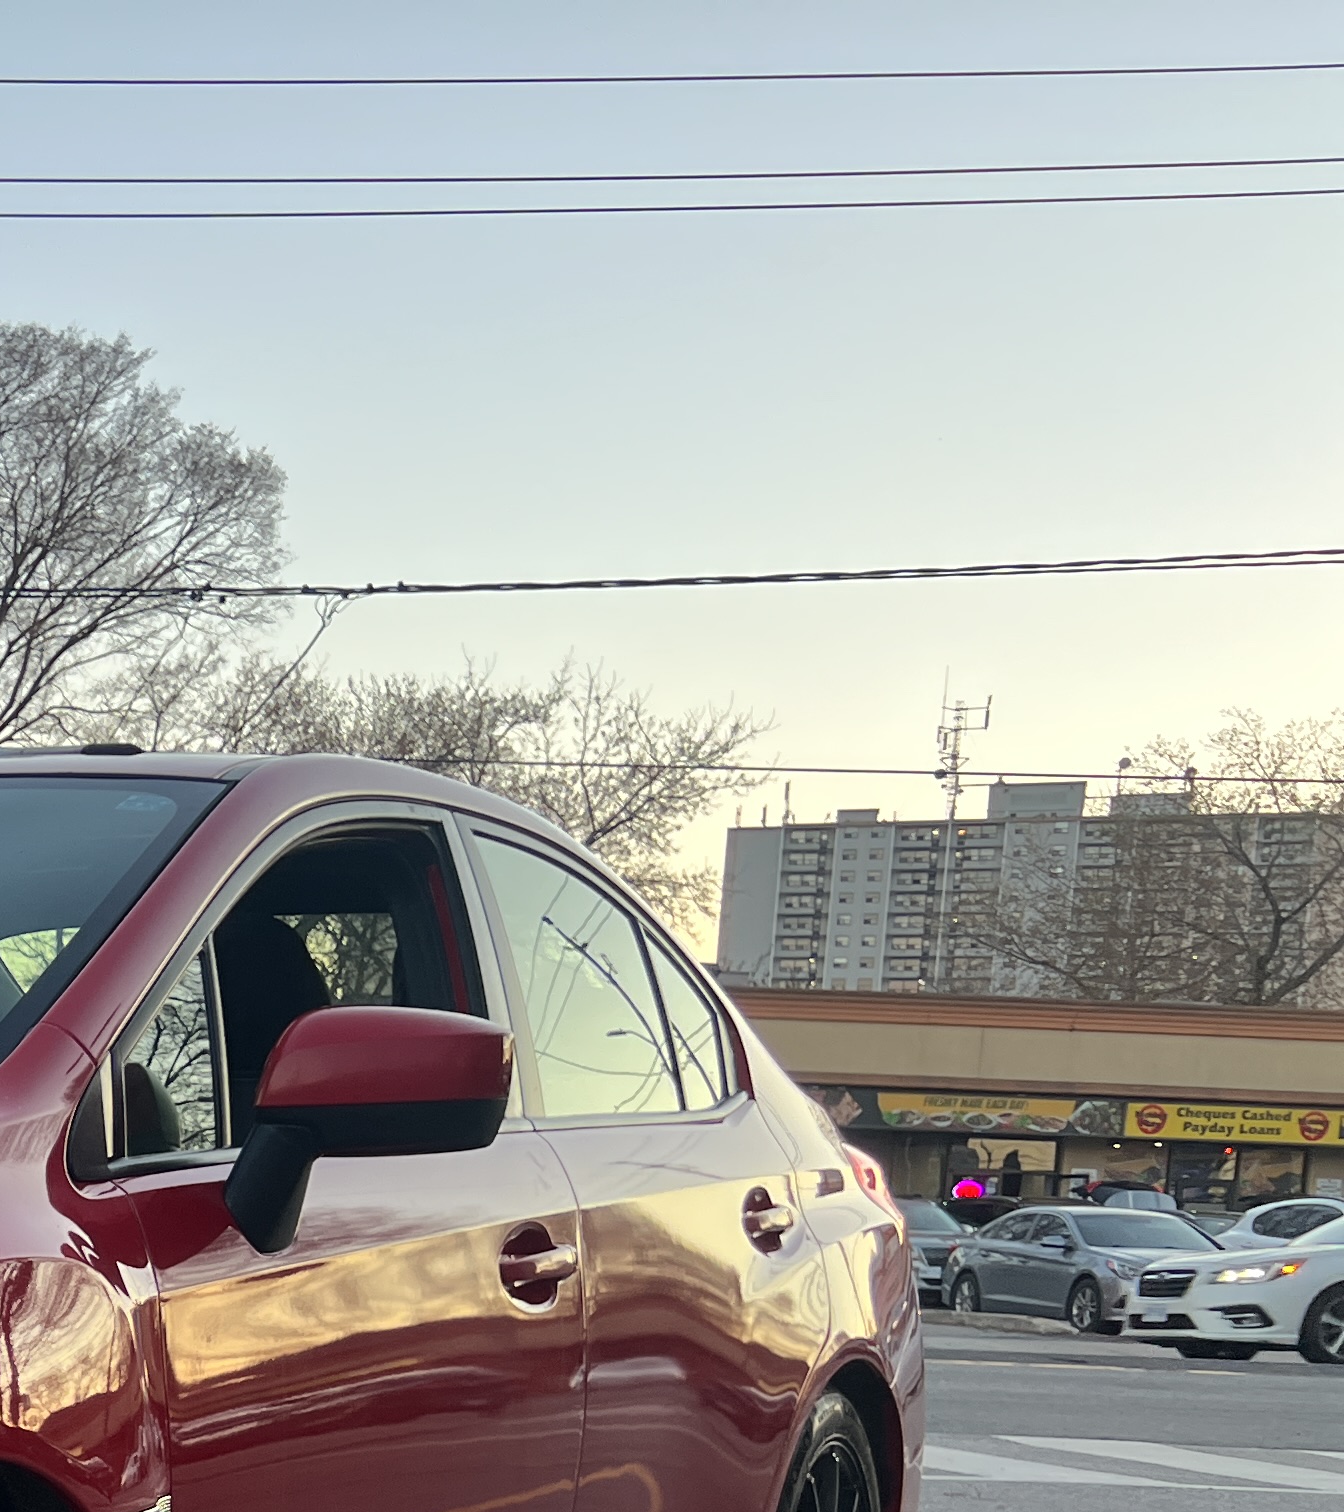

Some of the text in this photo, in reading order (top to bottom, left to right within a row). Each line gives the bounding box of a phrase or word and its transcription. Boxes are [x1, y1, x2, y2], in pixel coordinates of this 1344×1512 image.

[1176, 1107, 1237, 1122] Cheques
[1241, 1109, 1293, 1122] Cashed
[1182, 1121, 1236, 1137] Payday
[1239, 1123, 1282, 1136] Loans
